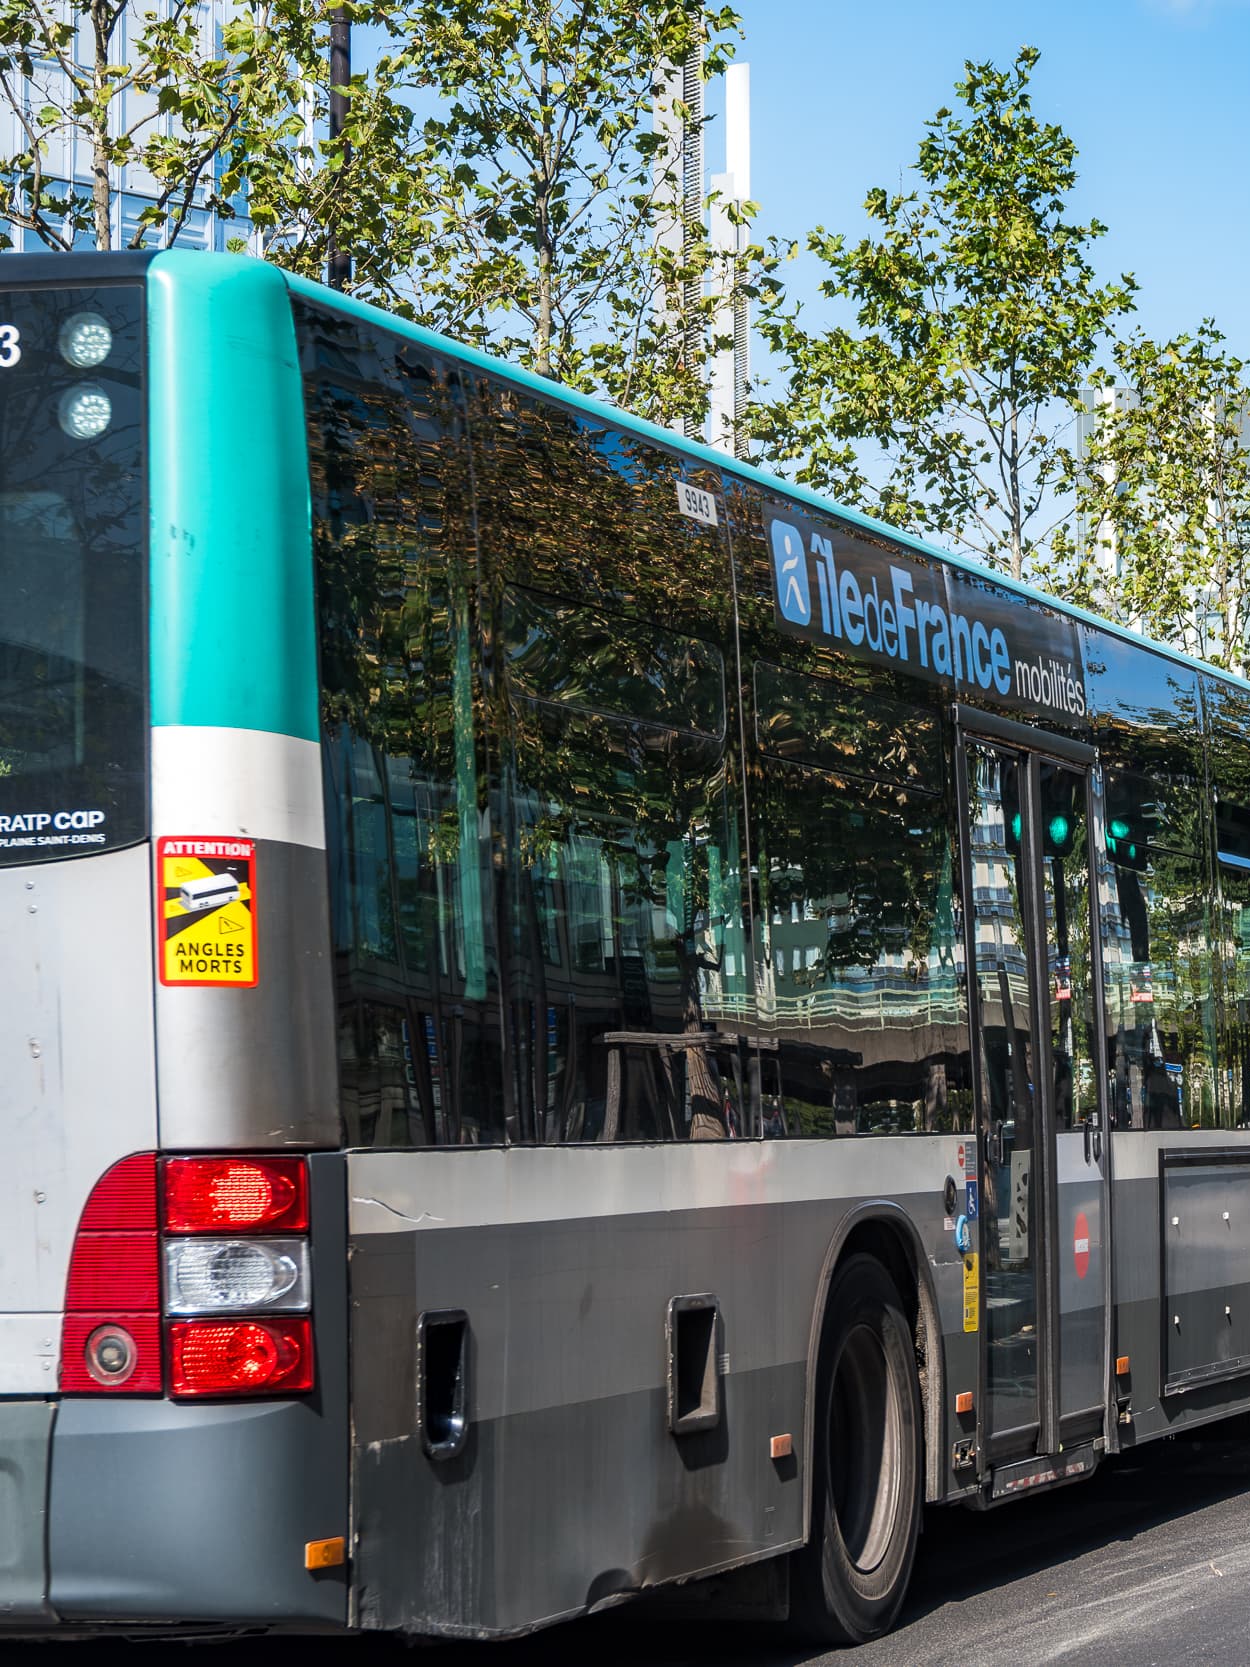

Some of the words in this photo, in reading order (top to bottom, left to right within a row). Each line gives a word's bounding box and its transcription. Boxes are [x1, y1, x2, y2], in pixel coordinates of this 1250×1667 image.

[0, 325, 21, 367] 3
[685, 489, 710, 518] 9943
[1015, 656, 1087, 717] mobilités
[0, 814, 51, 833] RATP
[37, 833, 106, 846] SAINT-DENIS
[163, 841, 250, 857] ATTENTION
[175, 942, 245, 957] ANGLES
[180, 959, 242, 974] MORTS
